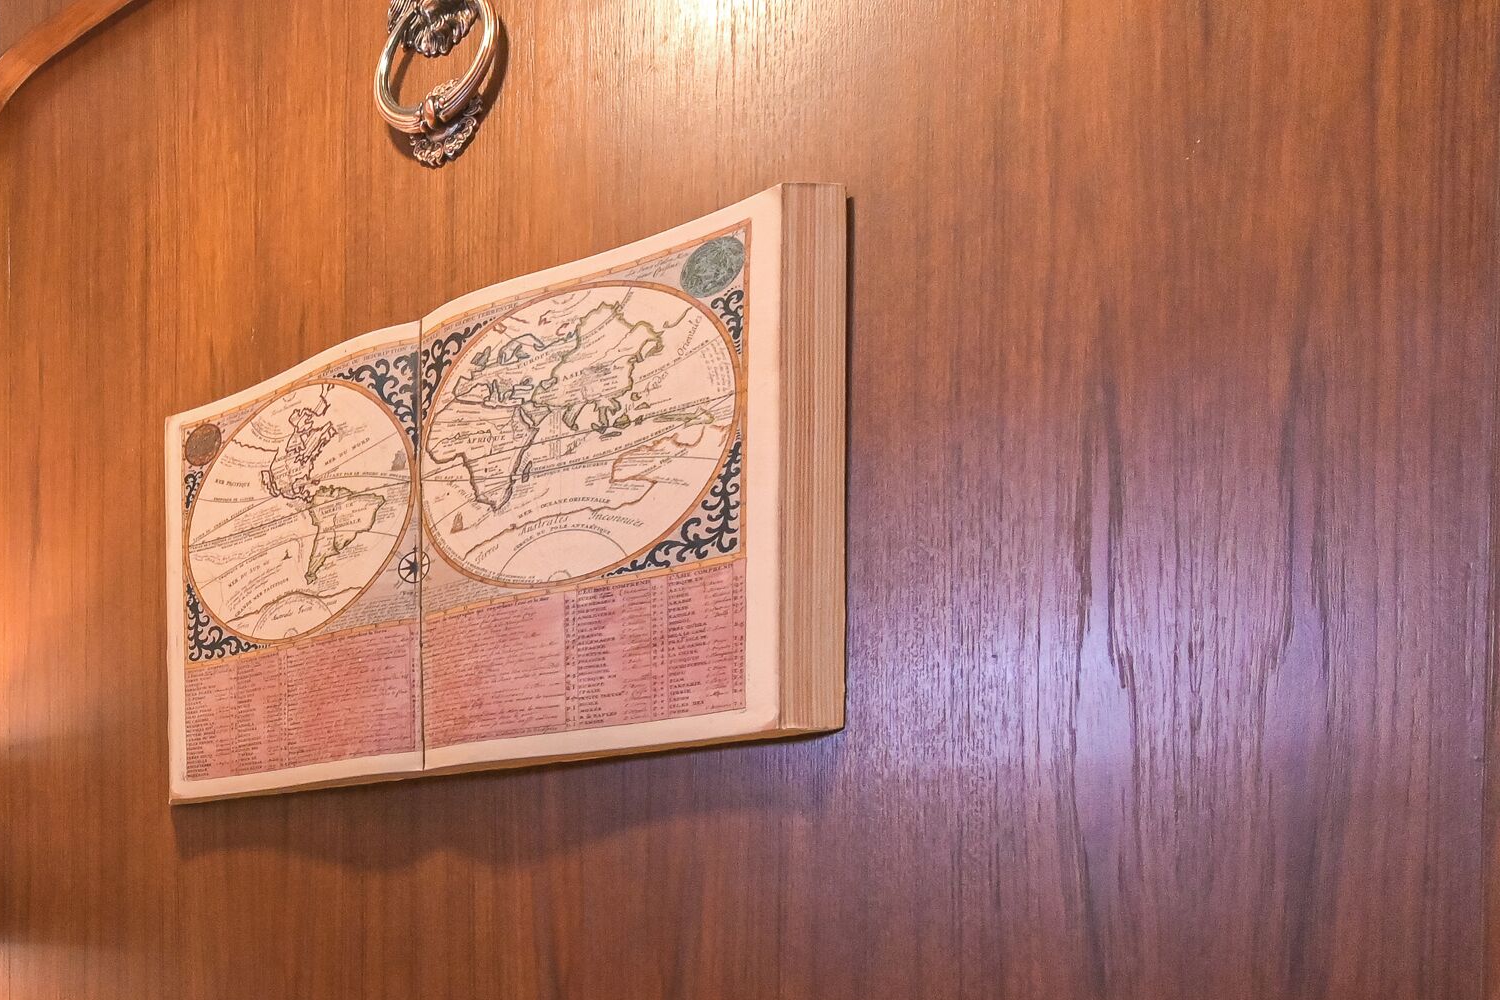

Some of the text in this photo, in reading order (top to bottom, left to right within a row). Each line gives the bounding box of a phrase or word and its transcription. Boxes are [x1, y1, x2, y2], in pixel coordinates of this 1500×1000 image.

[517, 351, 550, 369] EUROPE
[562, 370, 584, 382] ASIE
[467, 435, 506, 445] AFRIQUE
